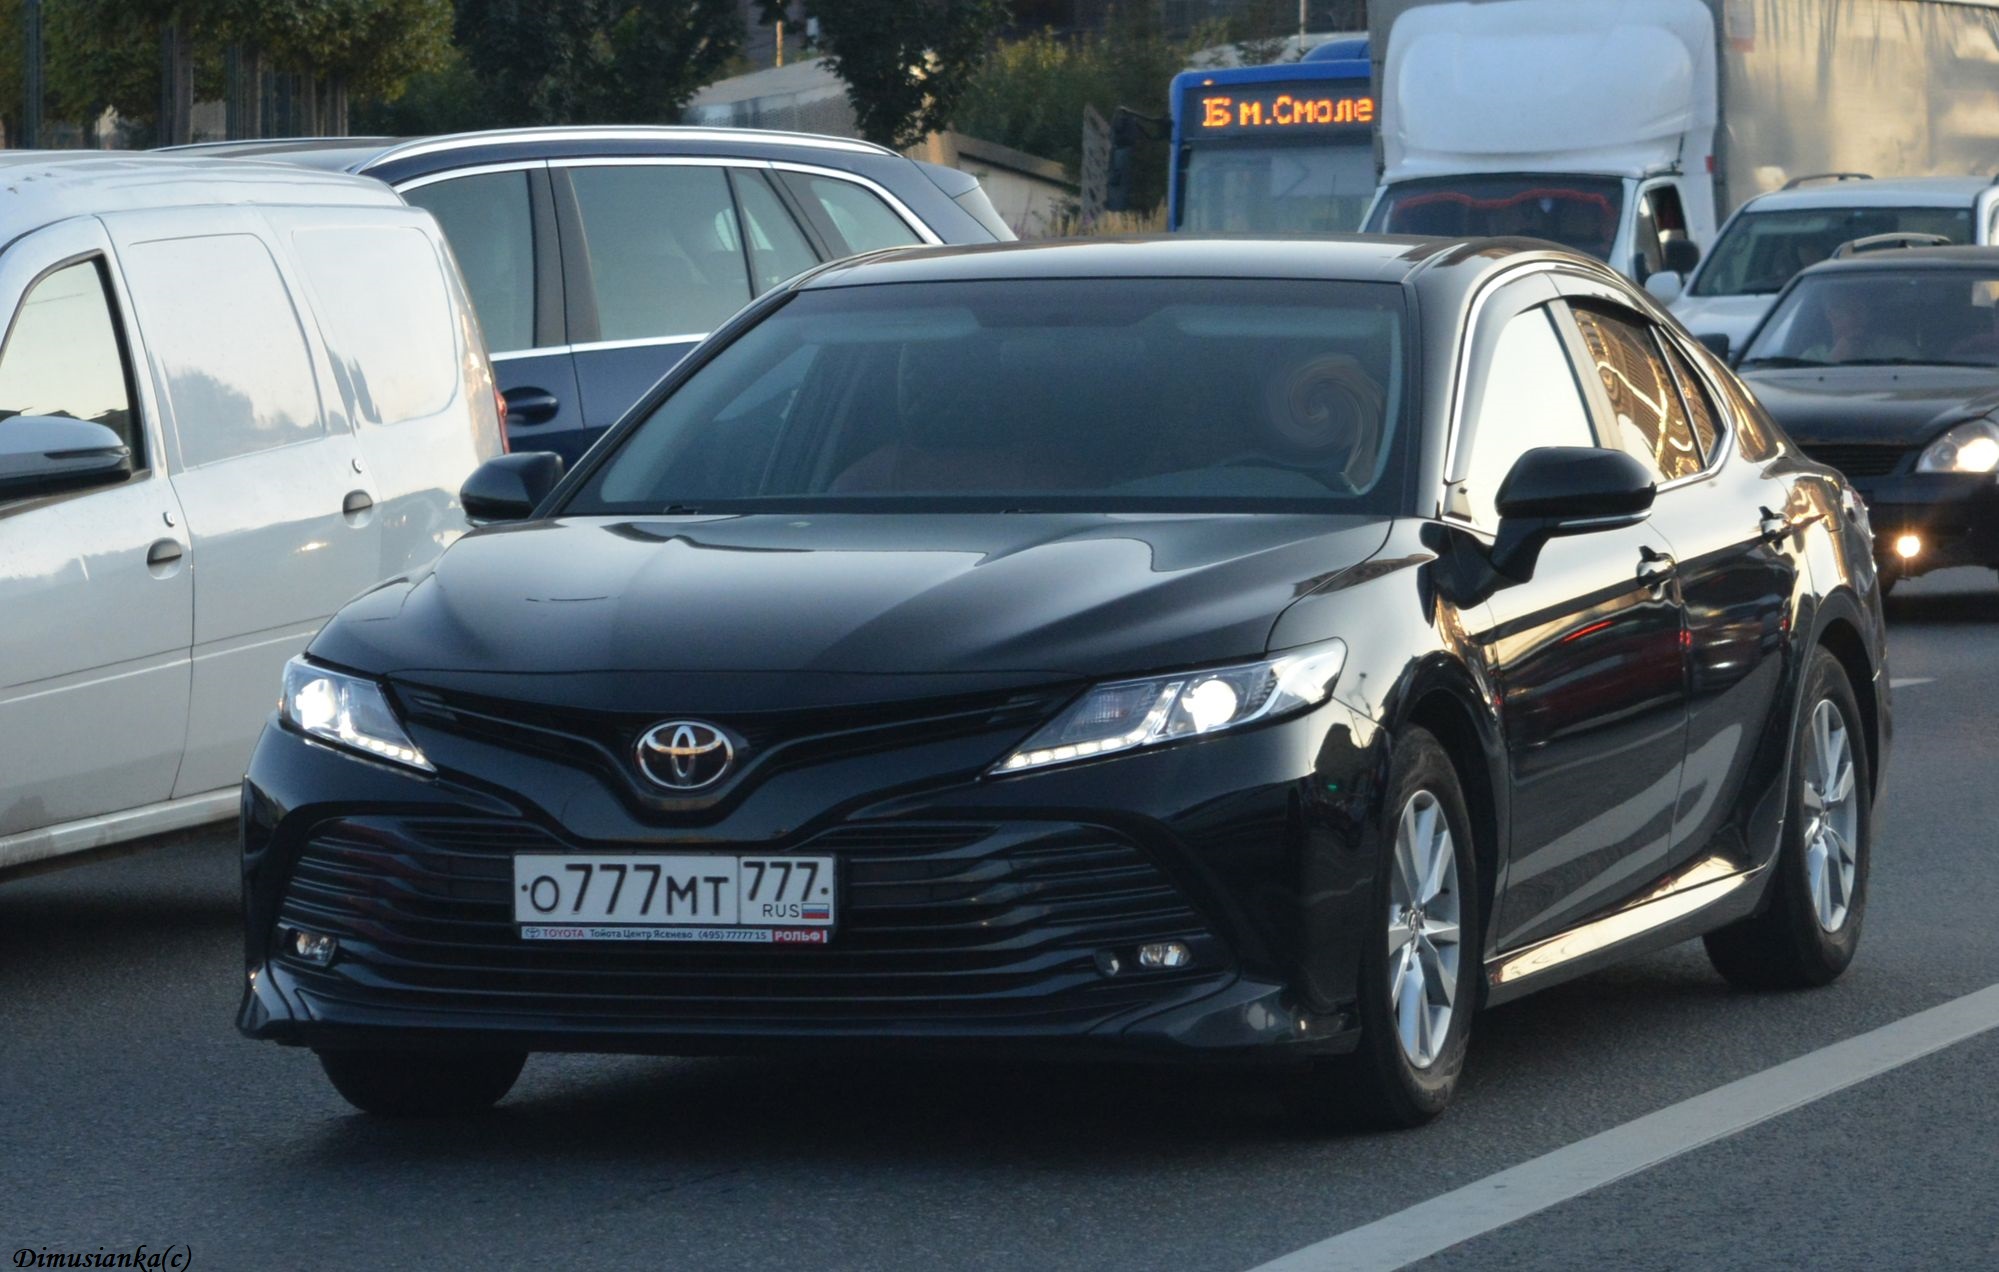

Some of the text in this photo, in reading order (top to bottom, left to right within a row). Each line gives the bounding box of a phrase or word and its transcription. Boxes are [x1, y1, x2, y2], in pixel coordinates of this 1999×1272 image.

[743, 861, 820, 902] 777
[762, 903, 800, 918] RUS
[543, 928, 585, 938] TOYOTA
[590, 928, 622, 939] Тойота
[623, 929, 651, 941] Центр
[653, 929, 692, 940] Ясенево
[774, 930, 822, 943] РОЛЬФ
